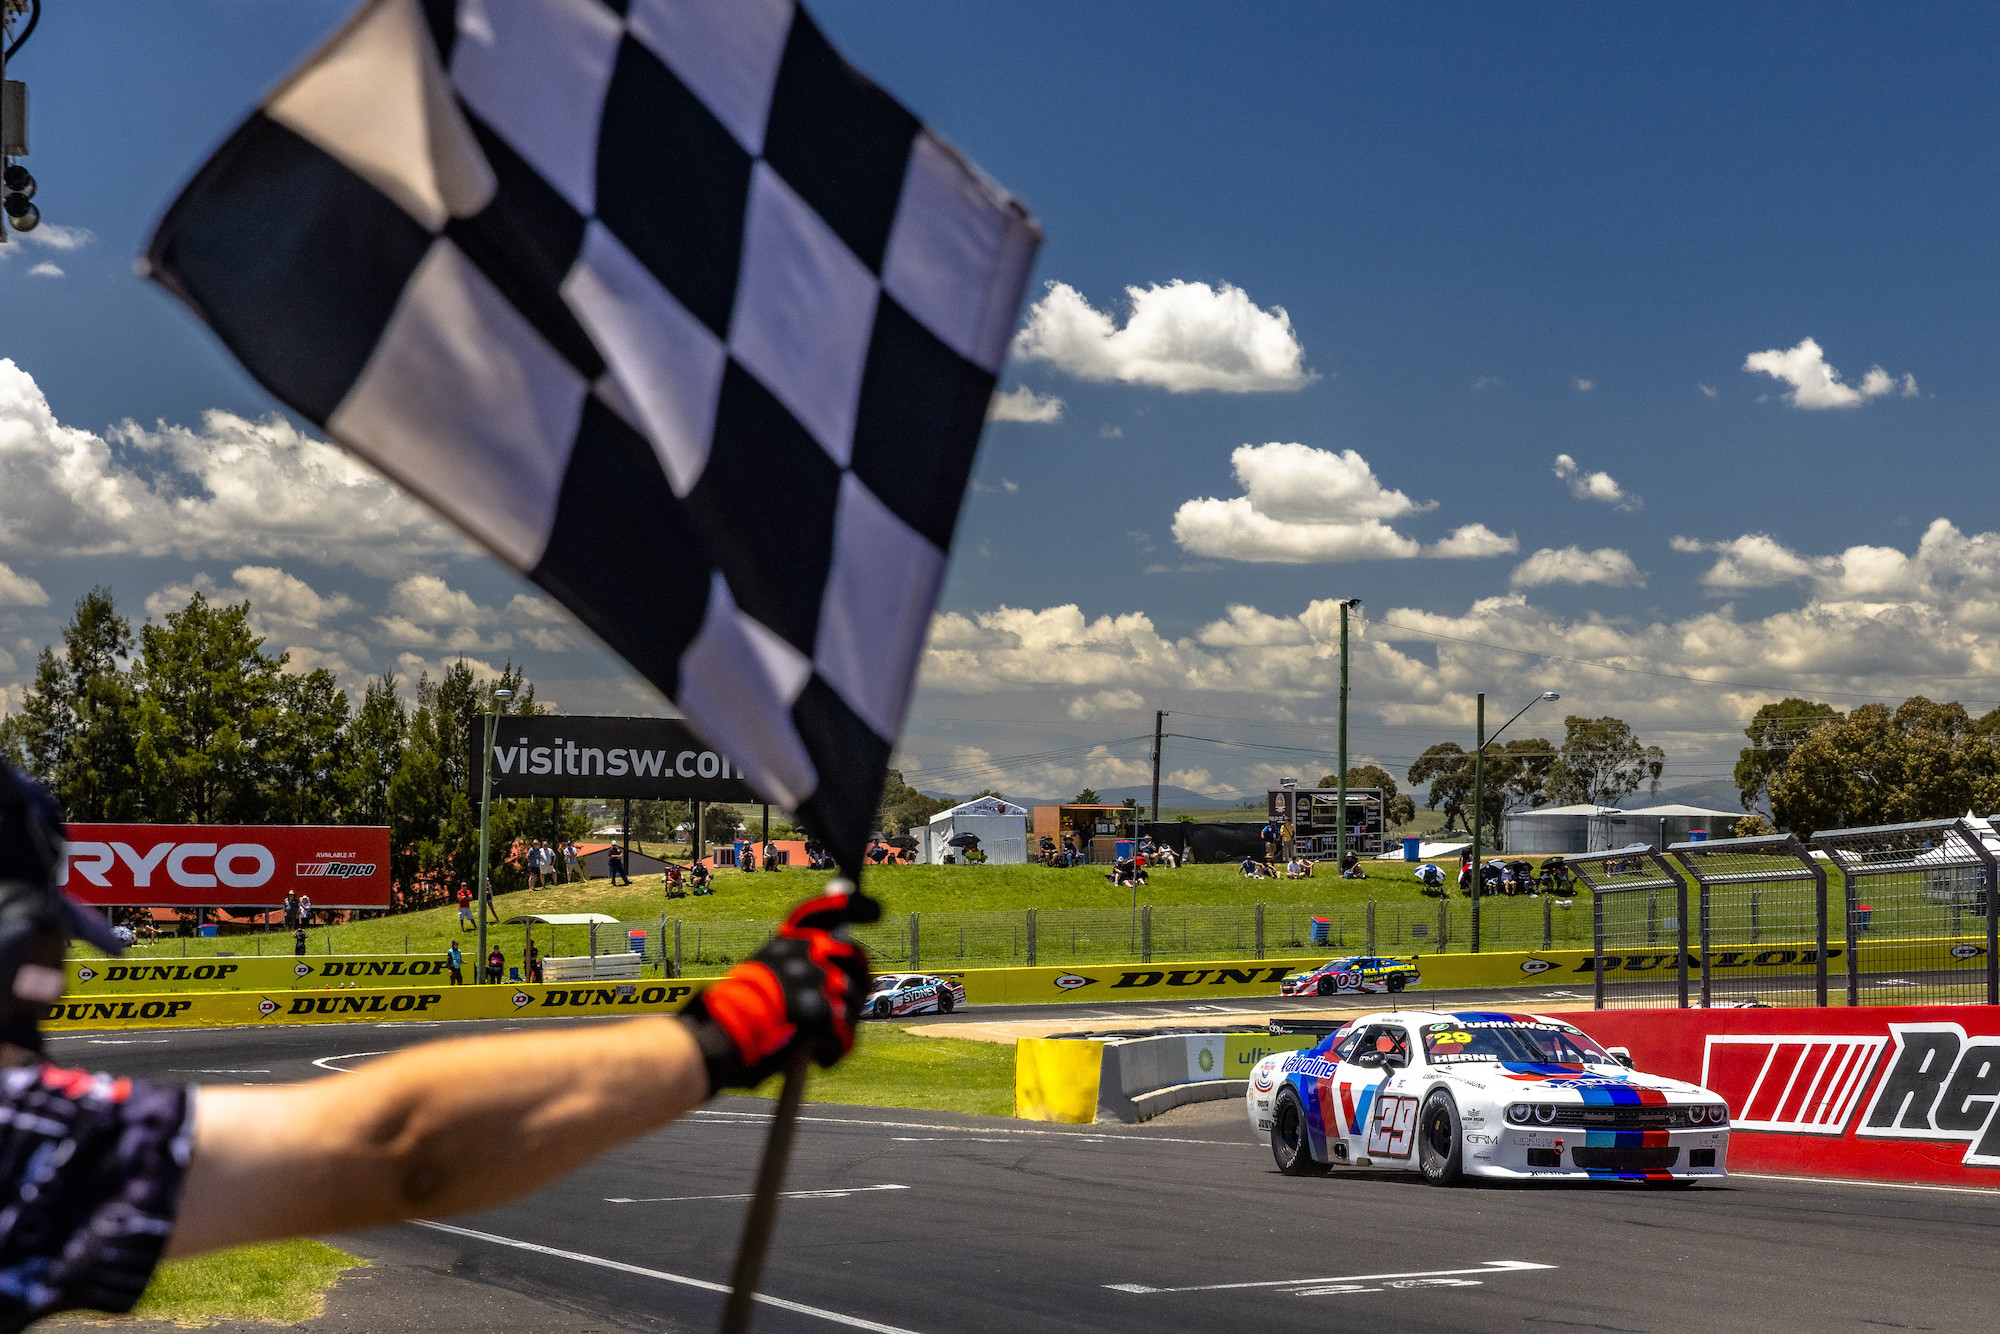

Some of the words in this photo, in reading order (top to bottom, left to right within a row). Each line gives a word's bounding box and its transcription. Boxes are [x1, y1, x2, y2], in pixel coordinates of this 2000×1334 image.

[54, 841, 275, 888] RYCO
[325, 862, 376, 878] Repco
[319, 961, 449, 976] DUNLOP
[1573, 949, 1842, 972] DUNLOP
[104, 965, 238, 981] DUNLOP
[1110, 966, 1297, 988] DUNL
[1337, 973, 1362, 989] 03
[541, 987, 691, 1006] DUNLOP
[903, 986, 938, 1003] SYDNEY
[45, 1001, 192, 1020] DUNLOP
[287, 994, 441, 1014] DUNLOP
[1434, 1032, 1472, 1044] 29
[1281, 1055, 1338, 1079] Valvoline
[1434, 1054, 1498, 1063] HERNE
[1368, 1095, 1420, 1159] 29
[1466, 1134, 1498, 1145] GRM
